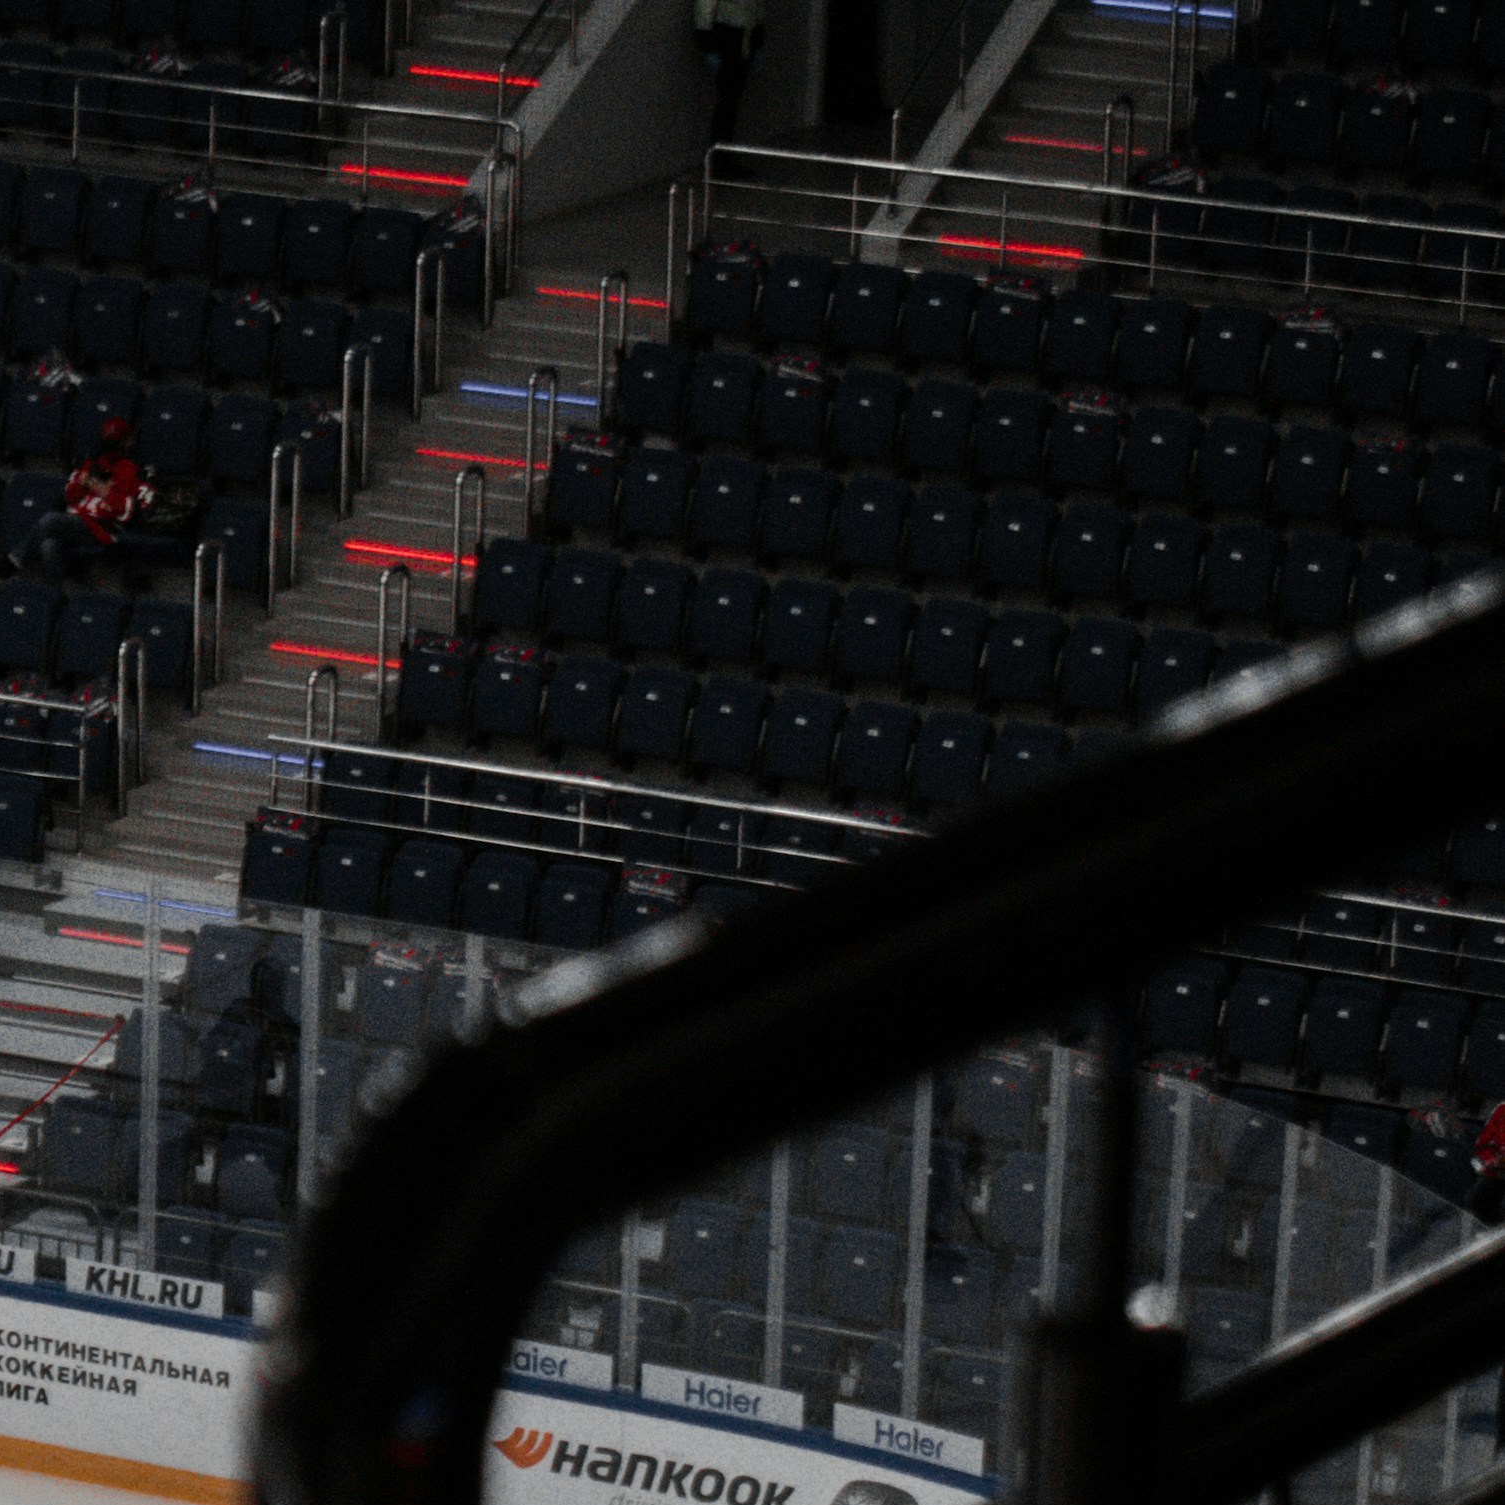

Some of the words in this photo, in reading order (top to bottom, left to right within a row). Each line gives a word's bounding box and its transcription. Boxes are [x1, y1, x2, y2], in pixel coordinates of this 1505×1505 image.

[84, 1266, 203, 1311] KHL.RU
[513, 1346, 568, 1378] aier
[684, 1378, 762, 1416] Haier
[874, 1419, 945, 1461] Haier
